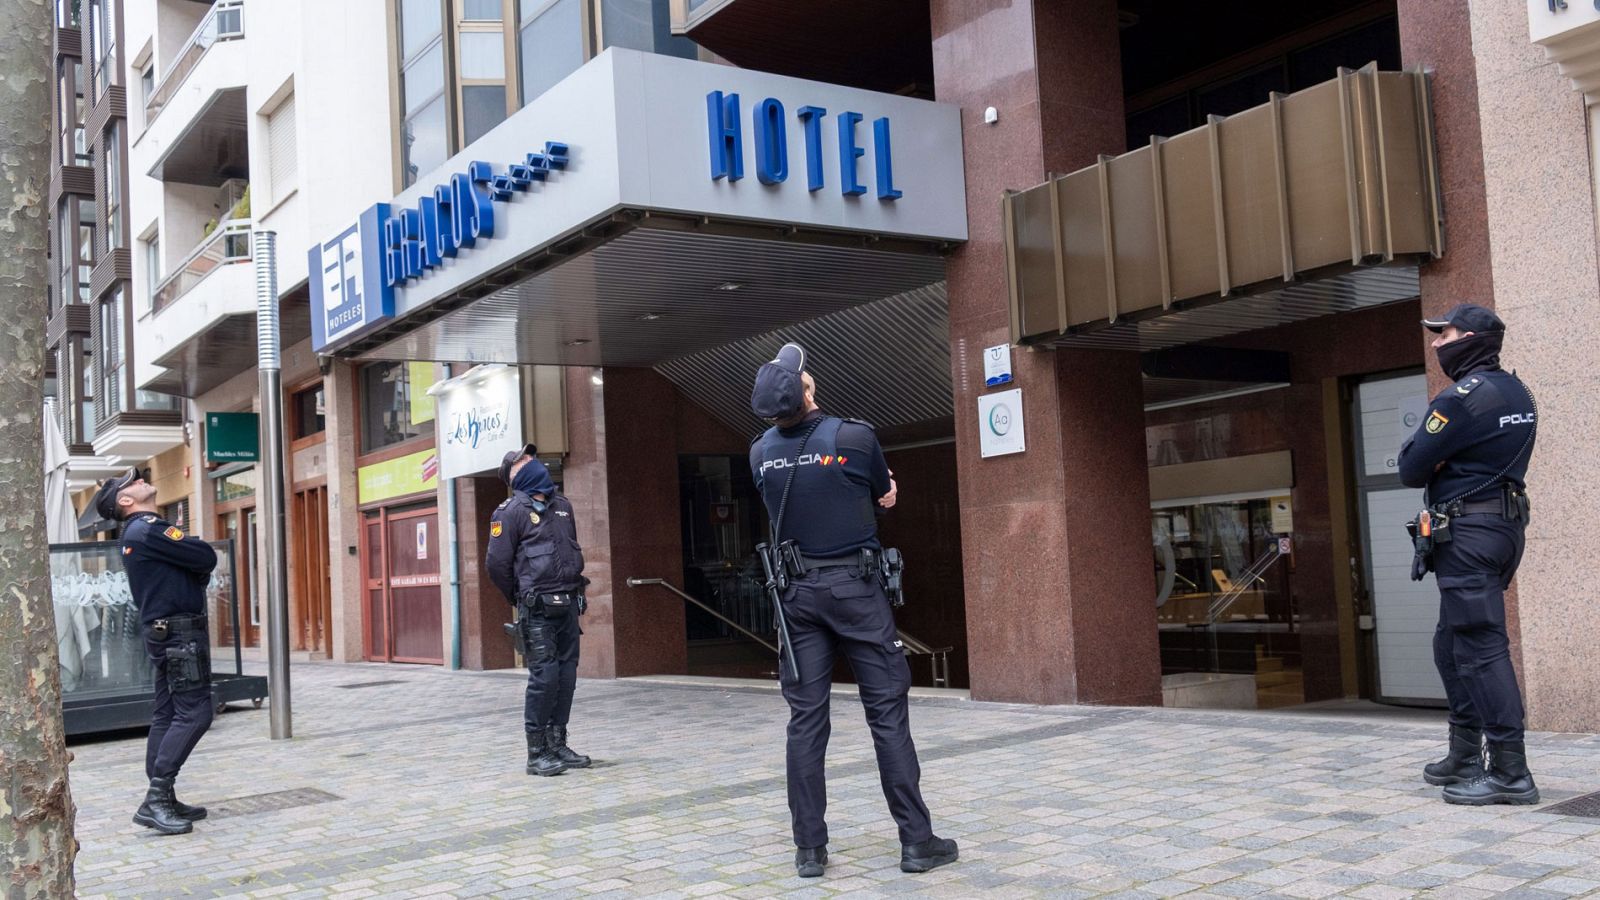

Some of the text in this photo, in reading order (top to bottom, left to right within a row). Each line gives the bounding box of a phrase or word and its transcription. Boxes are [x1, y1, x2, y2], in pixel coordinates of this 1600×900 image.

[706, 90, 903, 200] HOTEL
[384, 160, 495, 287] BRACOS
[329, 303, 362, 331] HOTELES
[762, 452, 823, 472] POLCIA
